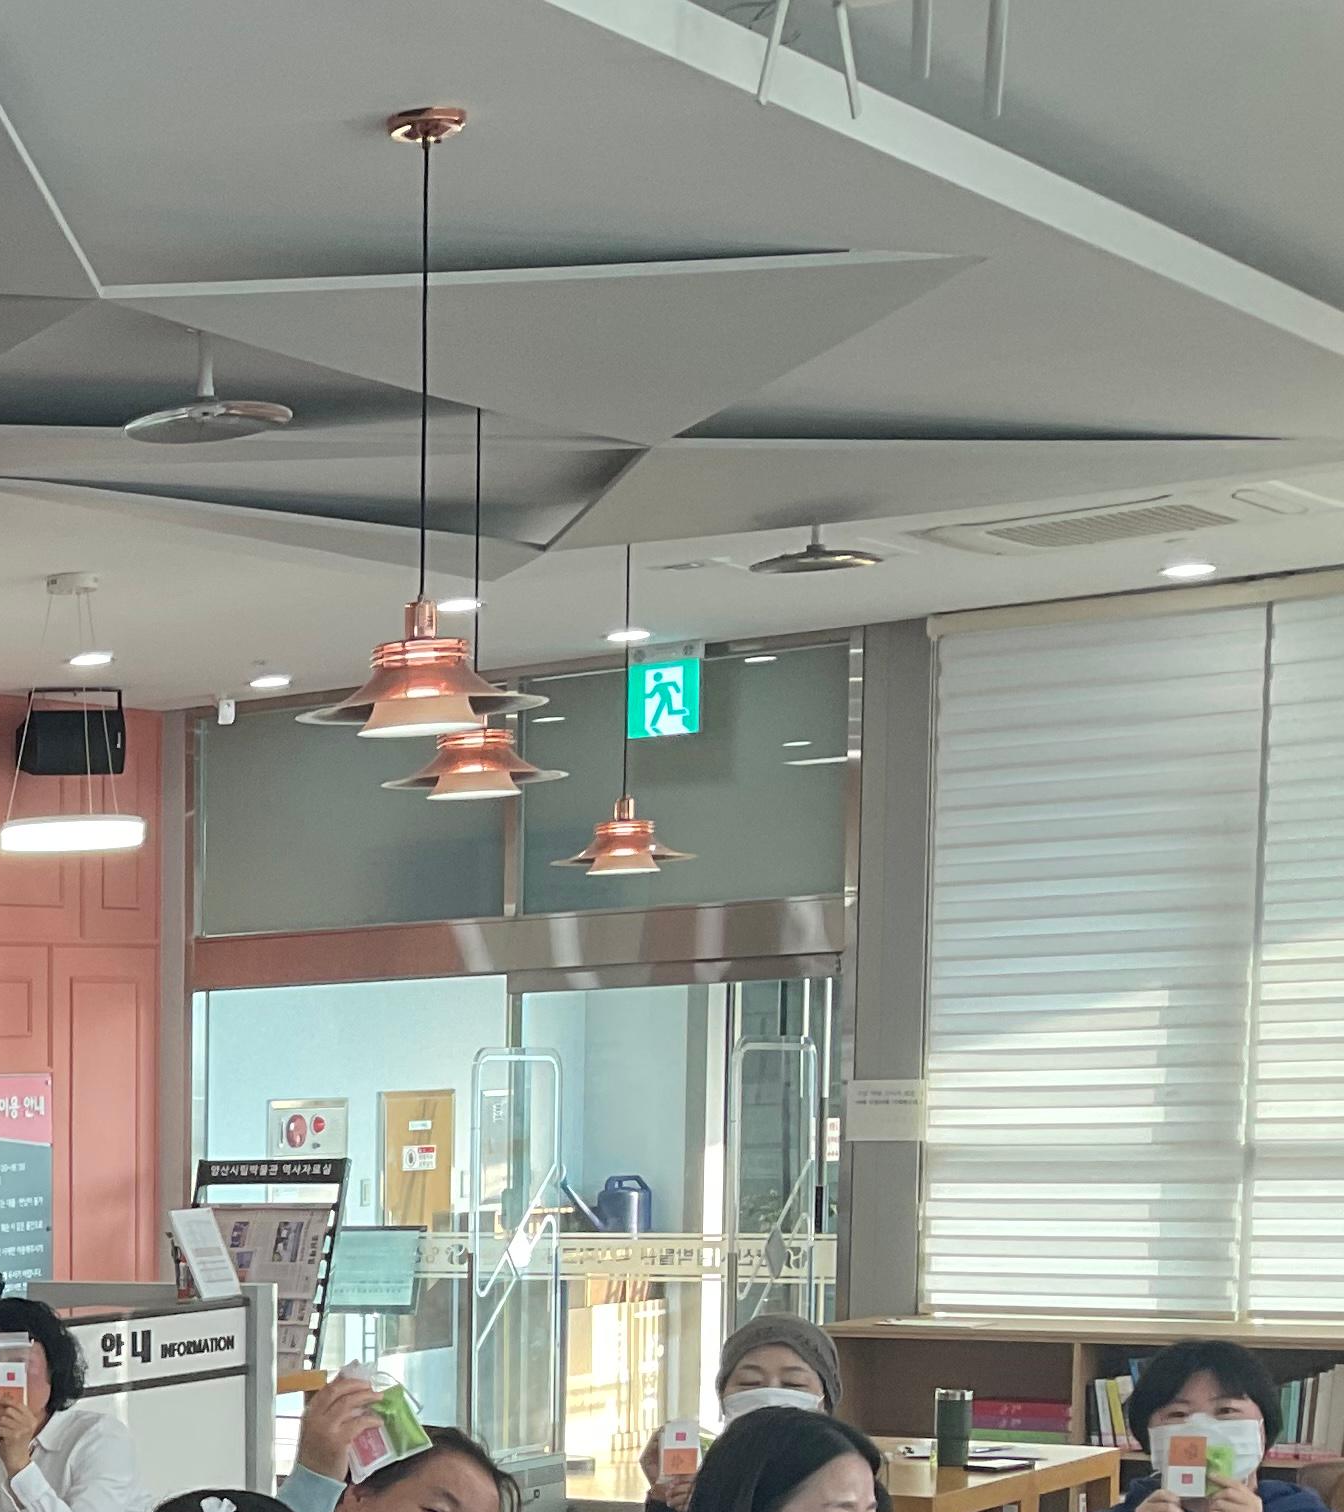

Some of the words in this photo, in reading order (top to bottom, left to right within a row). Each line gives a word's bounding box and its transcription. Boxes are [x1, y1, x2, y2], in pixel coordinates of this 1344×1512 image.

[23, 1096, 45, 1118] 안내
[210, 1164, 279, 1177] 양산시립박물관
[282, 1163, 332, 1175] 역사자료실
[101, 1329, 151, 1368] 안내
[160, 1335, 235, 1359] INFORMATION
